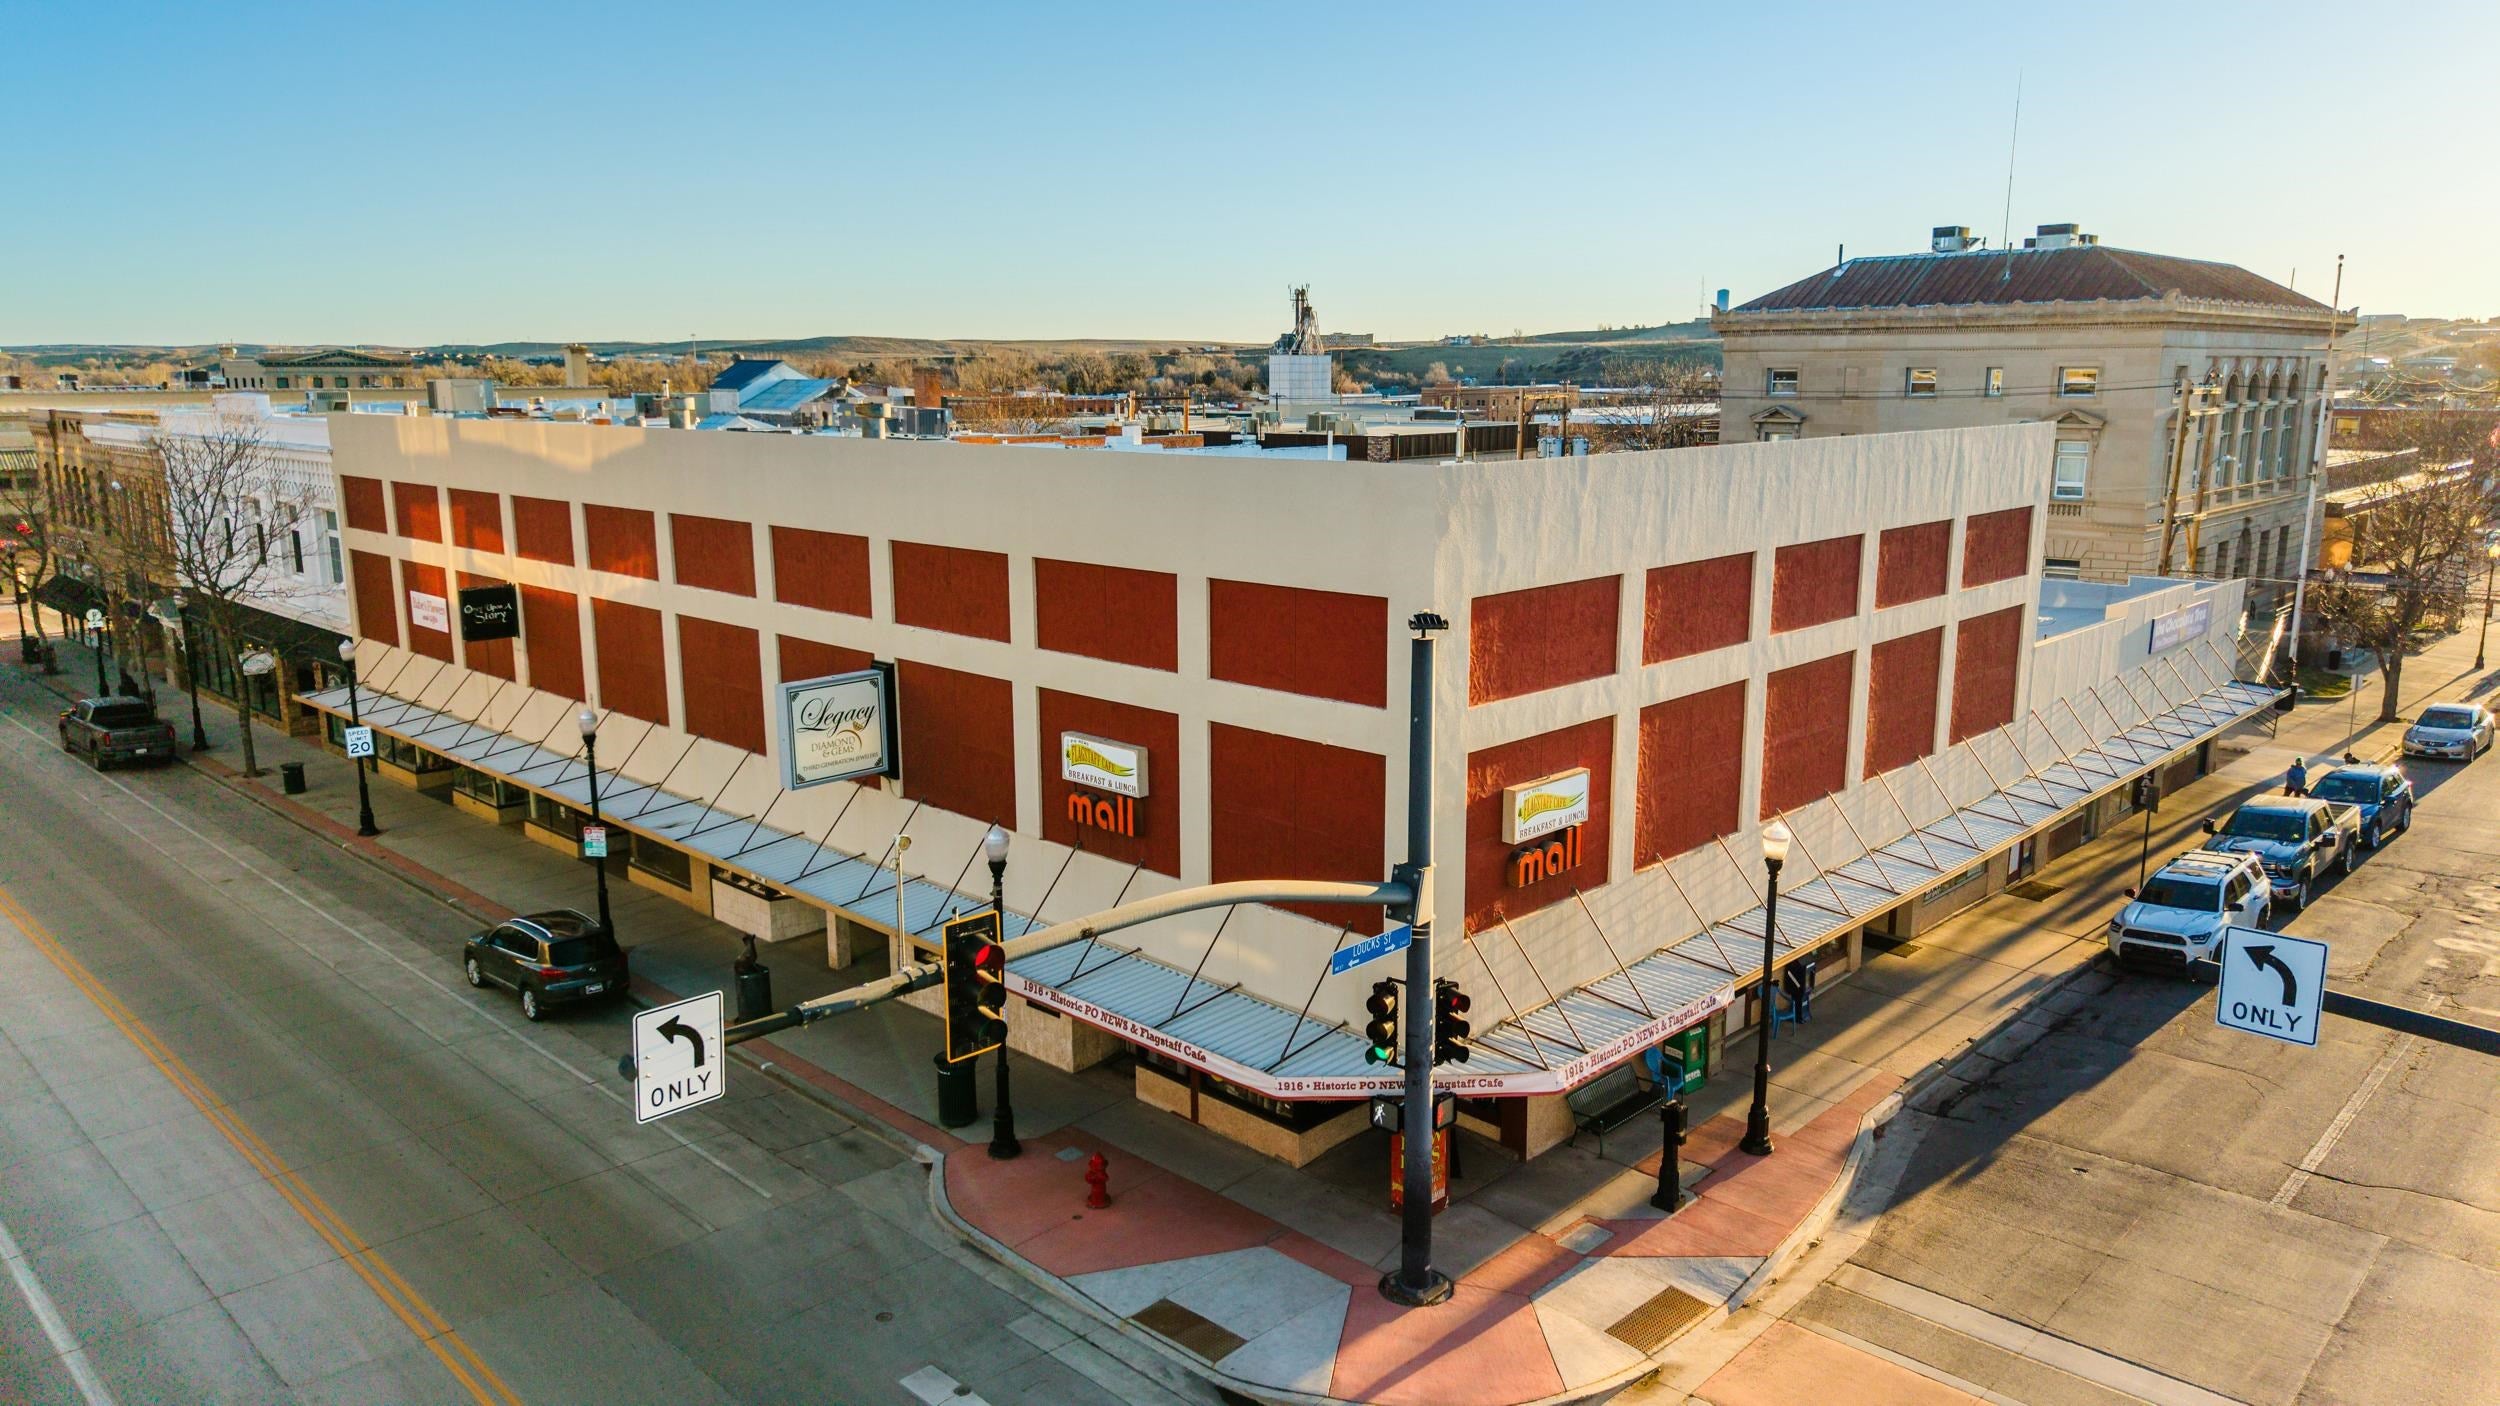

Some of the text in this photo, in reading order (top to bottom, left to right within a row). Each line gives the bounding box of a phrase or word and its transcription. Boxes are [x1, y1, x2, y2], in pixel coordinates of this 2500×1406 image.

[796, 696, 877, 738] Legacy
[350, 741, 370, 753] 20
[811, 736, 856, 752] DIAMOND
[831, 745, 854, 756] GEMS
[821, 757, 854, 769] GENERATION
[1068, 769, 1137, 794] BREAKFAST & LUNCH
[1068, 793, 1134, 838] mall
[1519, 810, 1585, 839] BREAKFAST & LUNCH
[1518, 825, 1583, 888] mall
[1352, 933, 1392, 957] LOUCKS ST
[1023, 980, 1207, 1063] 1916 Historic PO NEWS & Flagstaff Cafe
[2232, 1001, 2303, 1033] ONLY
[1564, 995, 1717, 1081] 1916 Historic PO NEWS & Flagstaff Cafe
[651, 1070, 712, 1107] ONLY
[1278, 1078, 1504, 1091] 1916 Historic PO NEW lagstaff Cafe
